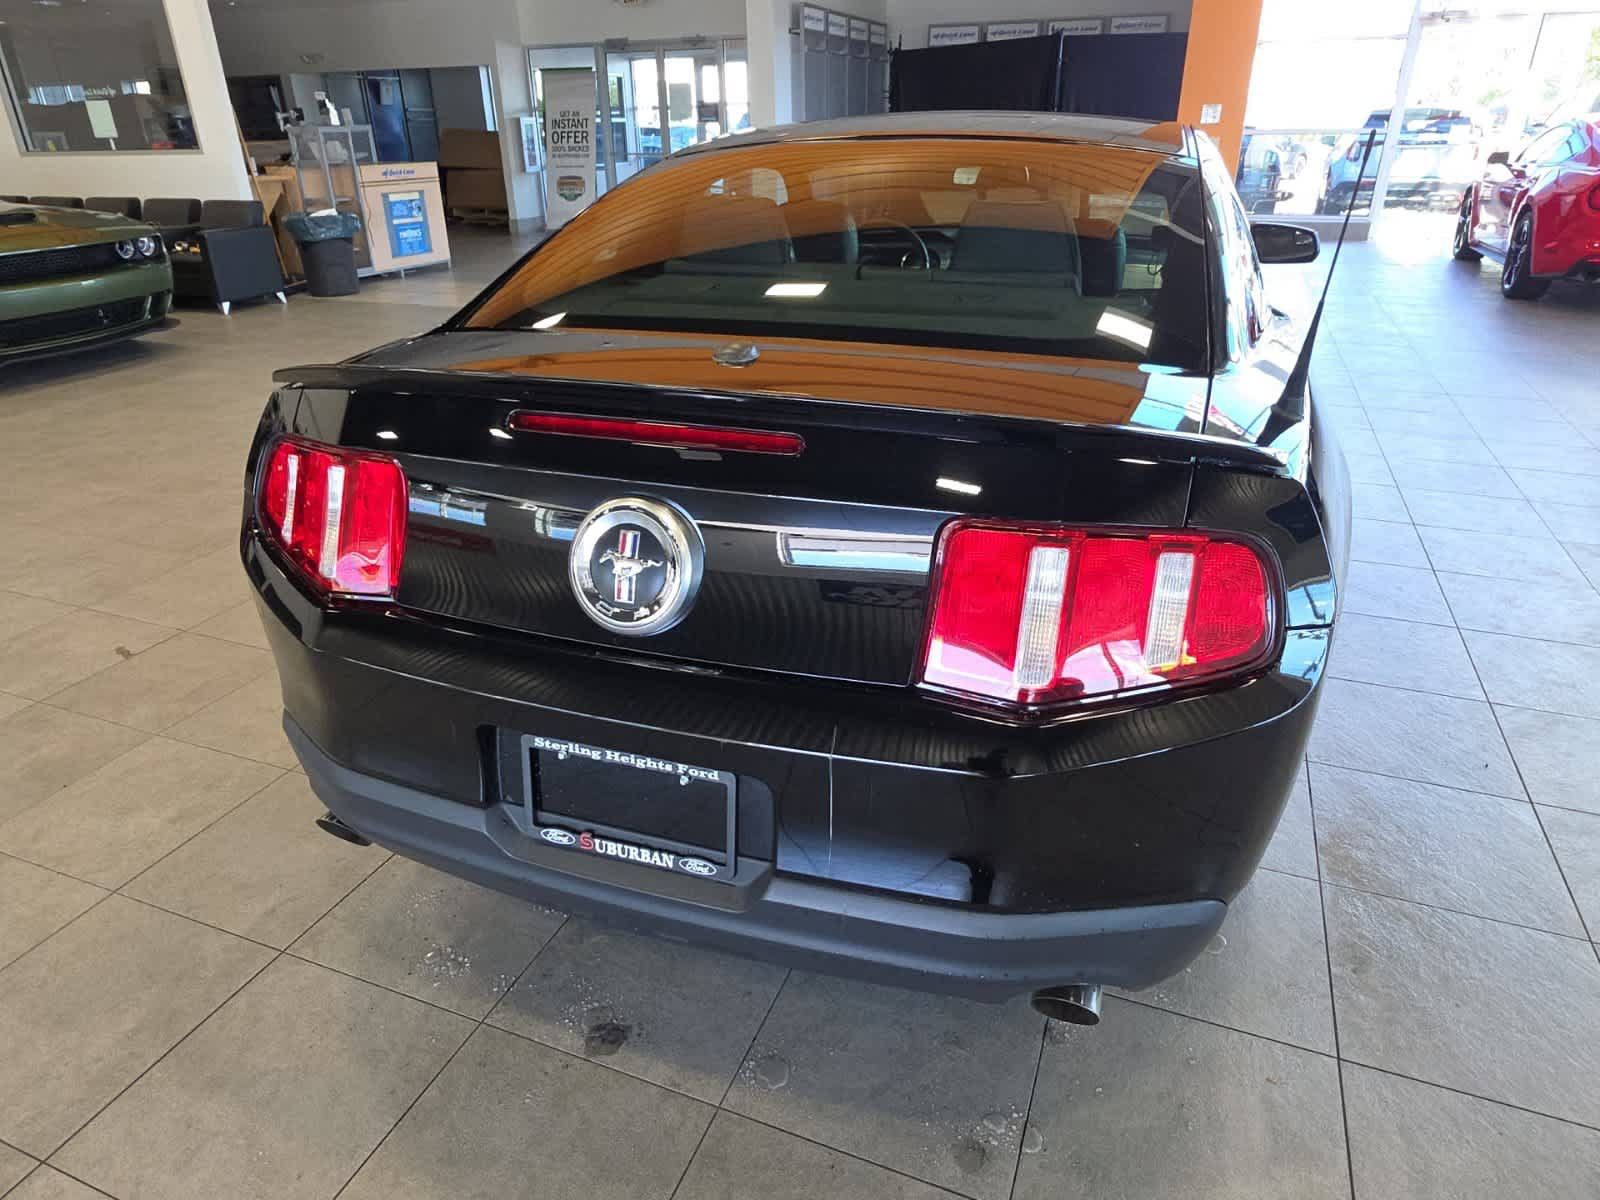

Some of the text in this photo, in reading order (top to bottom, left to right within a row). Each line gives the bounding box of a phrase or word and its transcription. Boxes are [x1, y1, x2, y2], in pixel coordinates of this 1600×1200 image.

[551, 118, 589, 129] INSTANT
[551, 130, 589, 145] OFFER
[534, 737, 719, 780] Sterling Heights Ford
[580, 832, 675, 869] SUBURBAN
